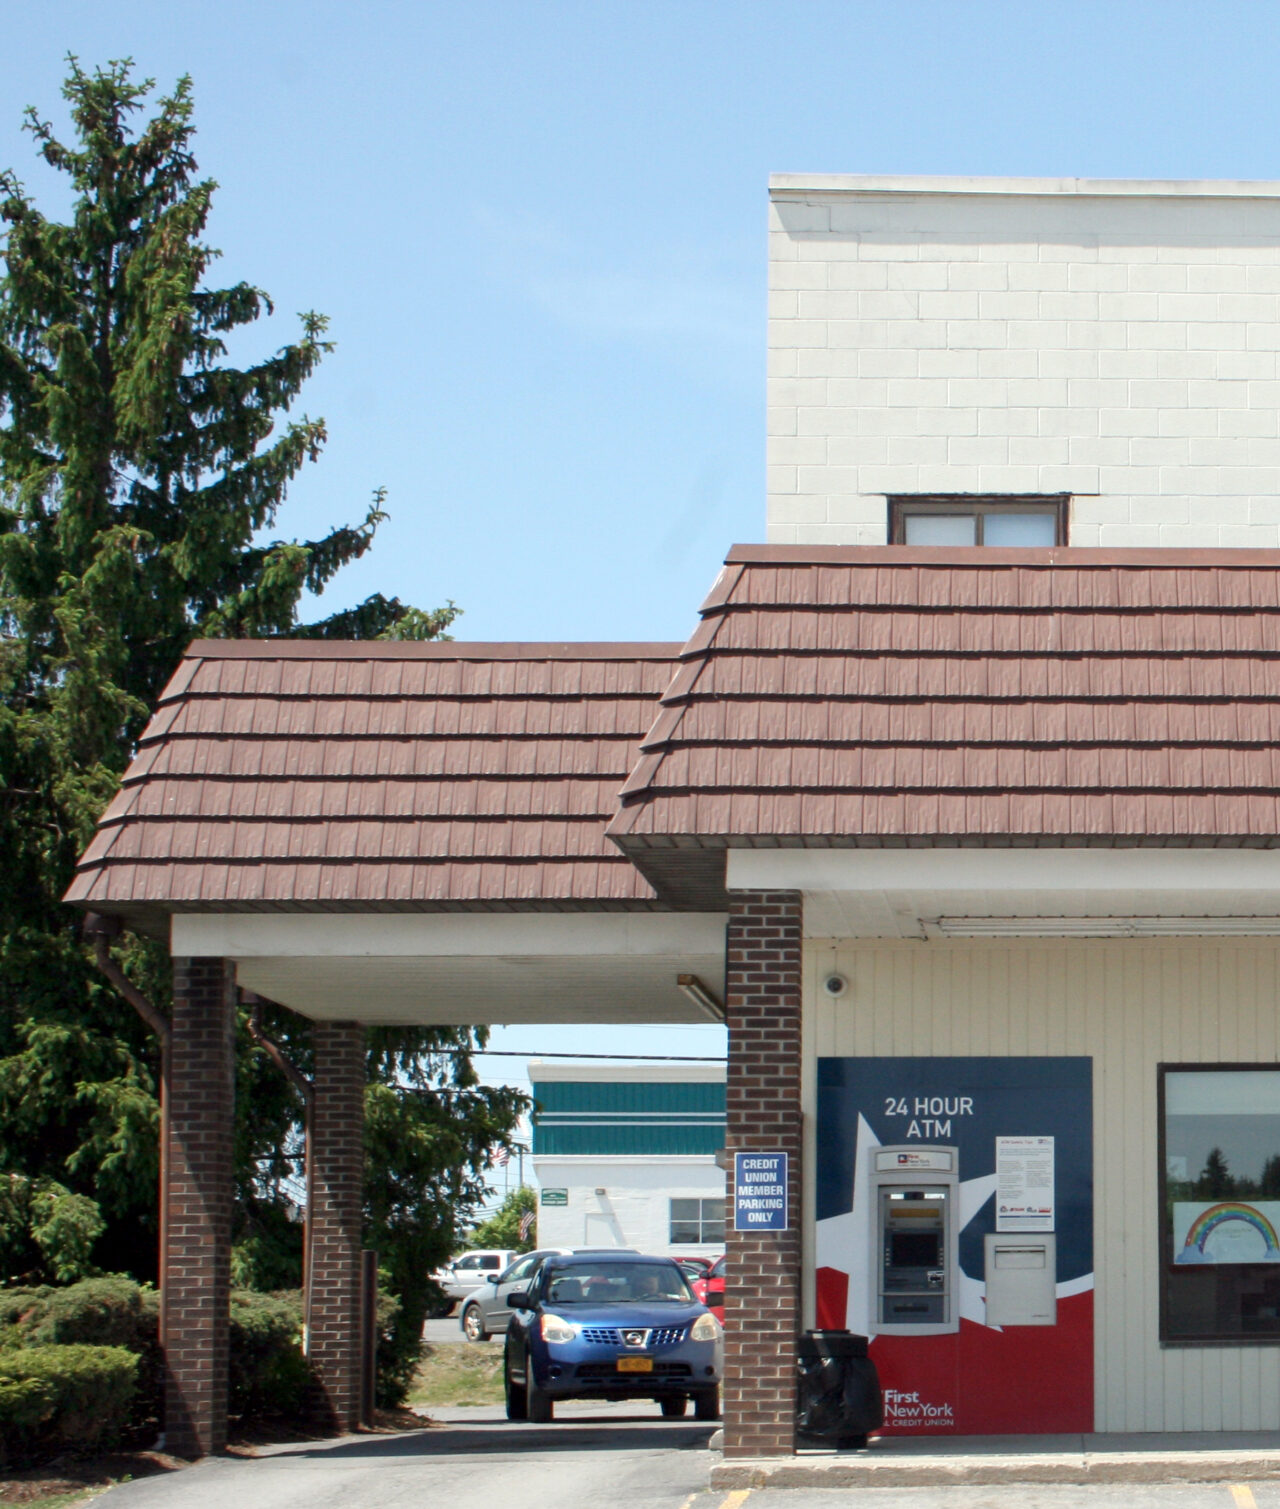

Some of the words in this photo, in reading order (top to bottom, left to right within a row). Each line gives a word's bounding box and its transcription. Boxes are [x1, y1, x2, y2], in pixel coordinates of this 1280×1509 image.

[885, 1097, 908, 1116] 24
[915, 1097, 974, 1116] HOUR
[906, 1119, 951, 1138] ATM
[743, 1159, 779, 1169] CREDIT
[745, 1172, 777, 1182] UNION
[738, 1186, 783, 1196] MEMBER
[739, 1199, 783, 1209] PARKING
[748, 1212, 774, 1223] ONLY
[884, 1389, 919, 1403] First
[892, 1419, 922, 1427] CREDIT
[924, 1419, 954, 1427] UNION
